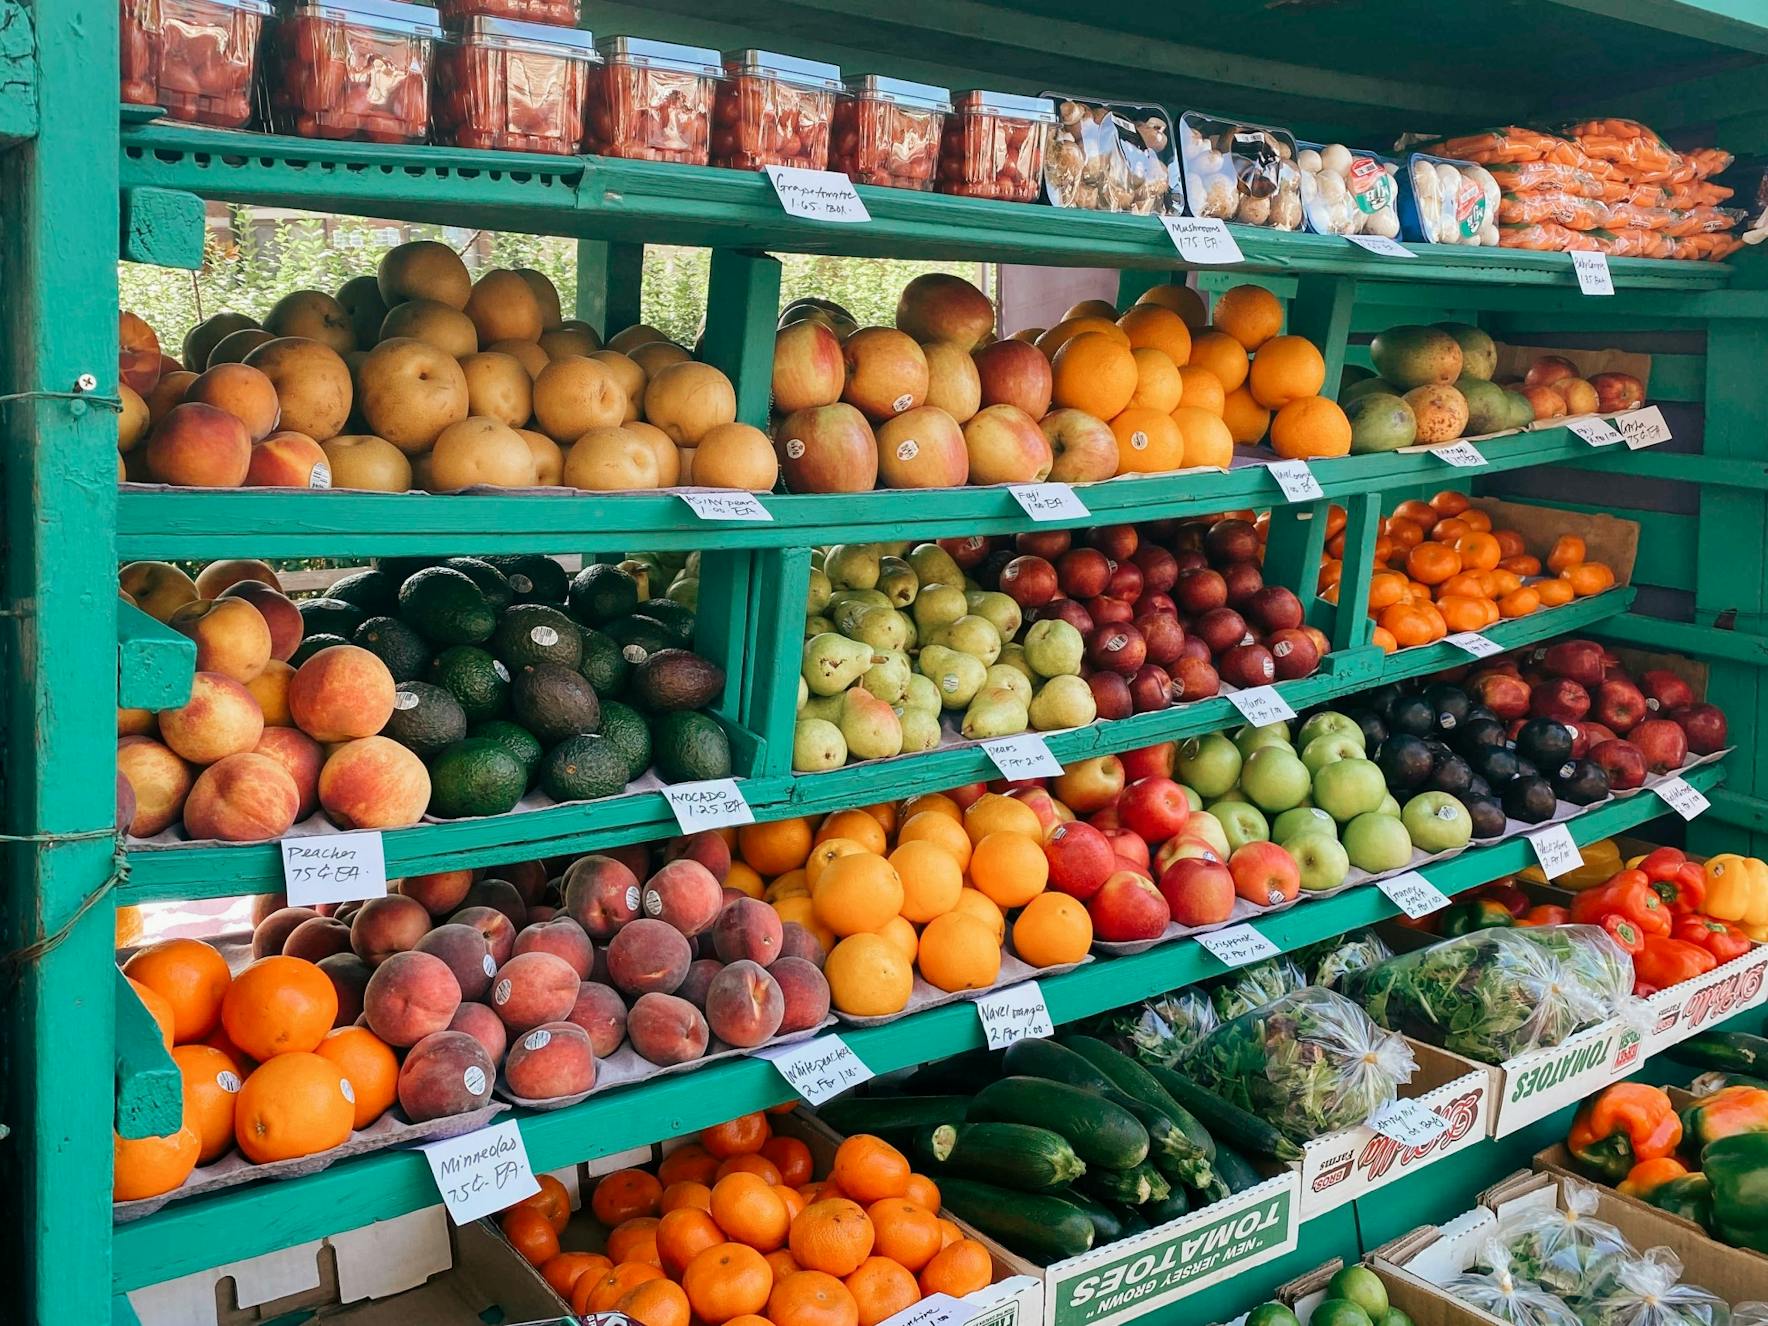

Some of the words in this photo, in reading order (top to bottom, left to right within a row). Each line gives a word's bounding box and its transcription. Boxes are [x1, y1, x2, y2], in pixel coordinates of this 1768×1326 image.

[671, 791, 727, 803] AVOCADO
[288, 846, 357, 864] Peaches
[981, 1004, 1010, 1023] Navel
[991, 1027, 1000, 1042] 2
[1512, 1036, 1613, 1103] TOMATOES
[802, 1084, 818, 1097] 2
[440, 1135, 517, 1181] Minneolas
[1319, 1149, 1354, 1171] Farms
[1070, 1202, 1281, 1307] TOMATOES
[1160, 1253, 1220, 1289] JERSEY
